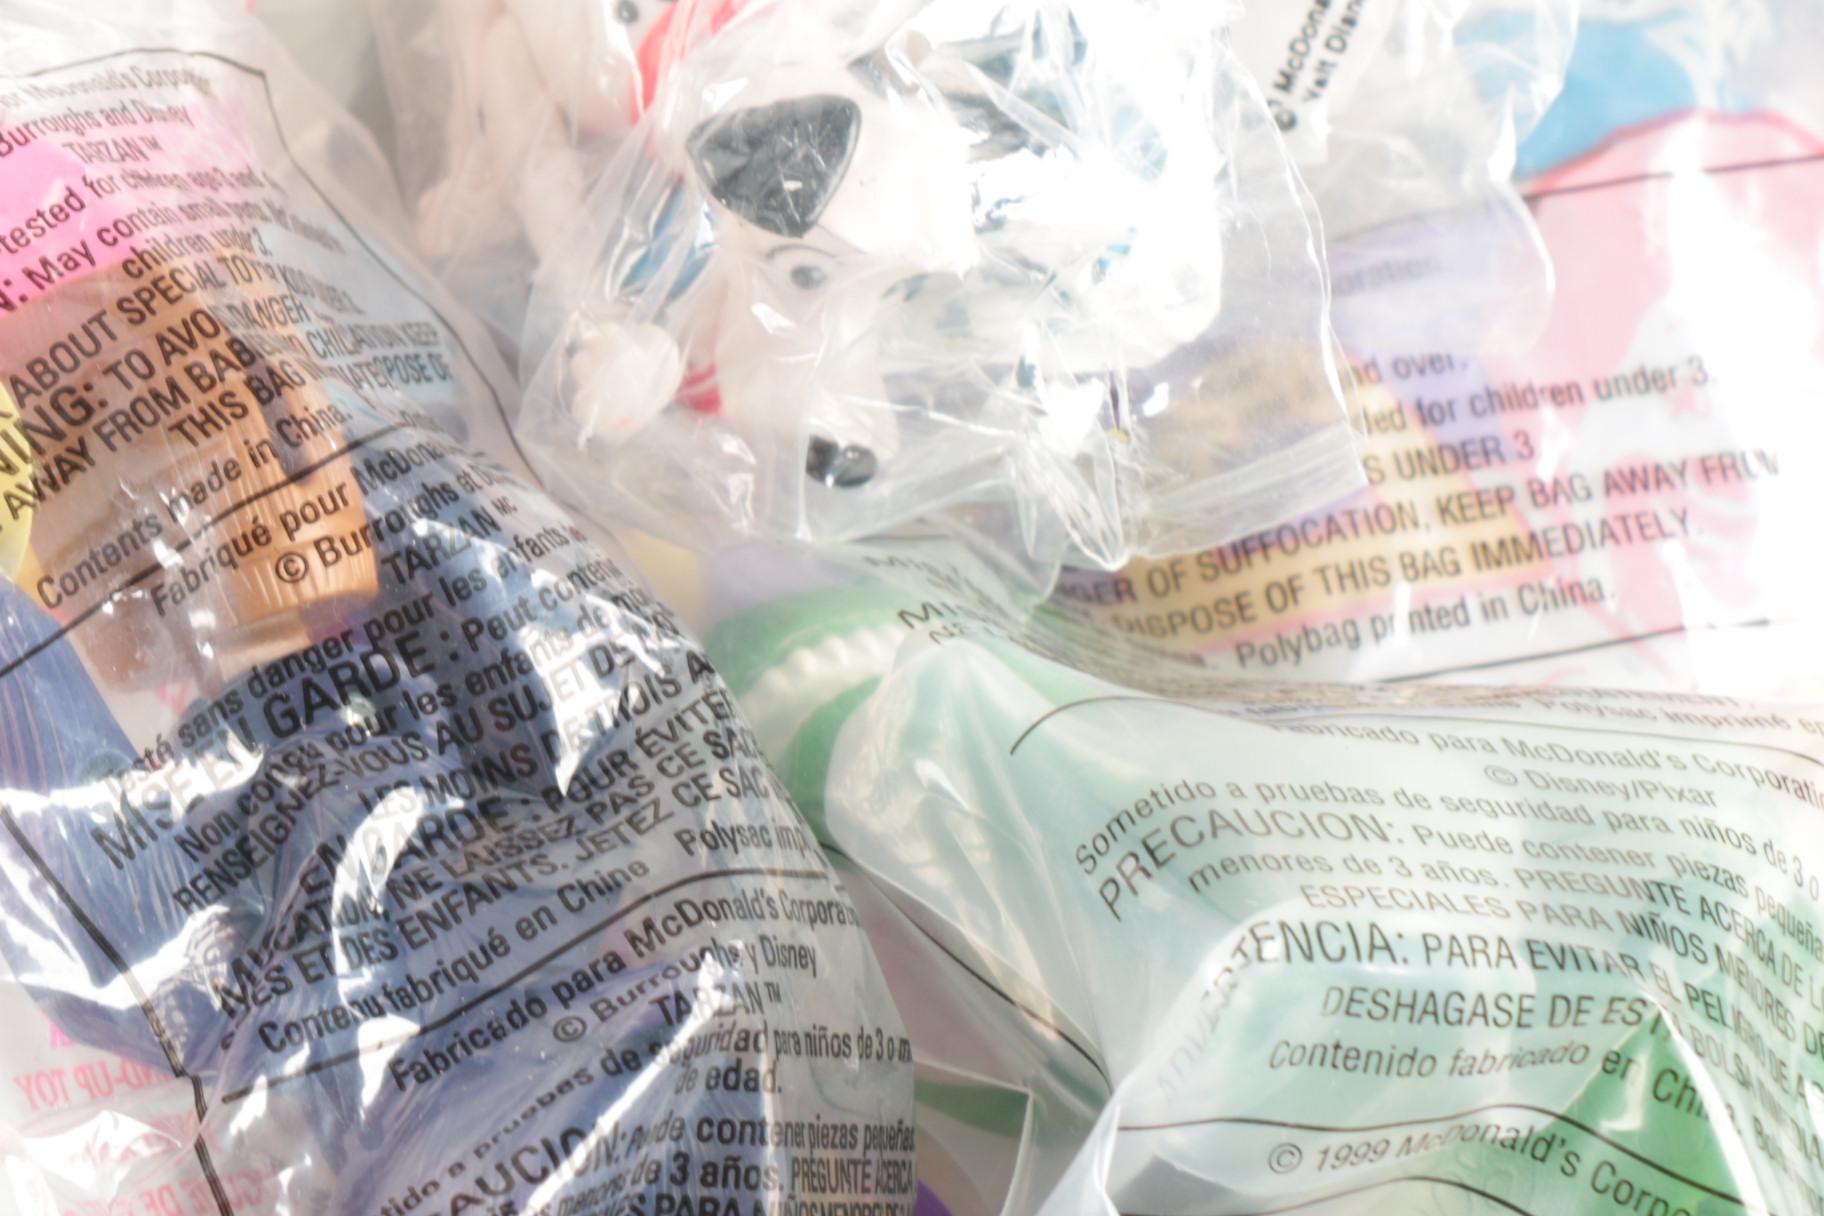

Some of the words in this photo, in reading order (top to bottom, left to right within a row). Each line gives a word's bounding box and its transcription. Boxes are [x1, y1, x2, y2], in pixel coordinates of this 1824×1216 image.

[22, 239, 96, 292] May
[9, 309, 119, 408] ABOUT
[1468, 374, 1585, 420] children
[1593, 363, 1678, 403] under
[2, 437, 96, 520] AWAY
[92, 377, 190, 452] FROM
[168, 390, 249, 448] THIS
[1393, 439, 1507, 481] UNDER
[36, 512, 165, 611] Contents
[150, 513, 271, 616] Fabriqué
[279, 482, 352, 541] pour
[313, 480, 460, 571] Burroughs
[1146, 563, 1191, 599] OF
[1437, 484, 1517, 526] KEEP
[1525, 474, 1593, 511] BAG
[1601, 457, 1695, 498] AWAY
[1264, 575, 1305, 615] OF
[1313, 553, 1393, 596] THIS
[1399, 544, 1462, 584] BAG
[1469, 506, 1705, 573] IMMEDIATELY.
[178, 693, 243, 745] sans
[248, 628, 355, 698] danger
[362, 592, 435, 646] pour
[262, 634, 436, 740] GARDE
[462, 604, 538, 652] Peut
[1233, 616, 1362, 671] Polybag
[425, 741, 539, 808] MOINS
[1502, 734, 1688, 773] McDonald's
[173, 732, 430, 916] RENSEIGNEZ-VOUS
[176, 810, 241, 863] Non
[387, 865, 443, 910] NE
[585, 773, 656, 824] PAS
[656, 745, 707, 779] CE
[1076, 778, 1217, 876] sometido
[1225, 781, 1247, 799] a
[1256, 779, 1385, 809] pruebas
[1439, 789, 1596, 828] seguridad
[1679, 815, 1759, 858] niños
[1791, 855, 1806, 889] 3
[1098, 807, 1407, 923] PRECAUCION:
[1411, 822, 1515, 857] Puede
[1520, 837, 1657, 870] contener
[1665, 851, 1751, 900] piezas
[347, 929, 400, 972] DES
[397, 850, 569, 950] ENFANTS.
[573, 796, 675, 863] JETEZ
[671, 777, 722, 810] CE
[259, 987, 390, 1054] Contenu
[385, 927, 513, 1012] fabriqué
[556, 859, 651, 916] Chine
[1186, 851, 1336, 894] menores
[1419, 858, 1511, 889] años.
[1512, 865, 1688, 917] PREGUNTE
[1779, 952, 1806, 998] DE
[1299, 884, 1512, 920] ESPECIALES
[1517, 898, 1616, 934] PARA
[1616, 910, 1709, 967] NIÑOS
[1420, 932, 1518, 971] PARA
[389, 991, 549, 1094] Fabricado
[554, 949, 629, 1010] para
[623, 885, 780, 959] McDonald's
[1322, 986, 1537, 1029] DESHAGASE
[600, 1045, 643, 1078] de
[704, 1058, 782, 1094] edad.
[1268, 1038, 1439, 1079] Contenido
[1449, 1038, 1591, 1078] fabricado
[671, 1152, 690, 1185] 3
[698, 1154, 782, 1191] años.
[790, 1158, 873, 1196] PREGUNTE
[695, 1116, 808, 1152] contener
[808, 1115, 859, 1154] piezas
[1313, 1137, 1392, 1173] 1999
[1395, 1120, 1579, 1179] McDonald's
